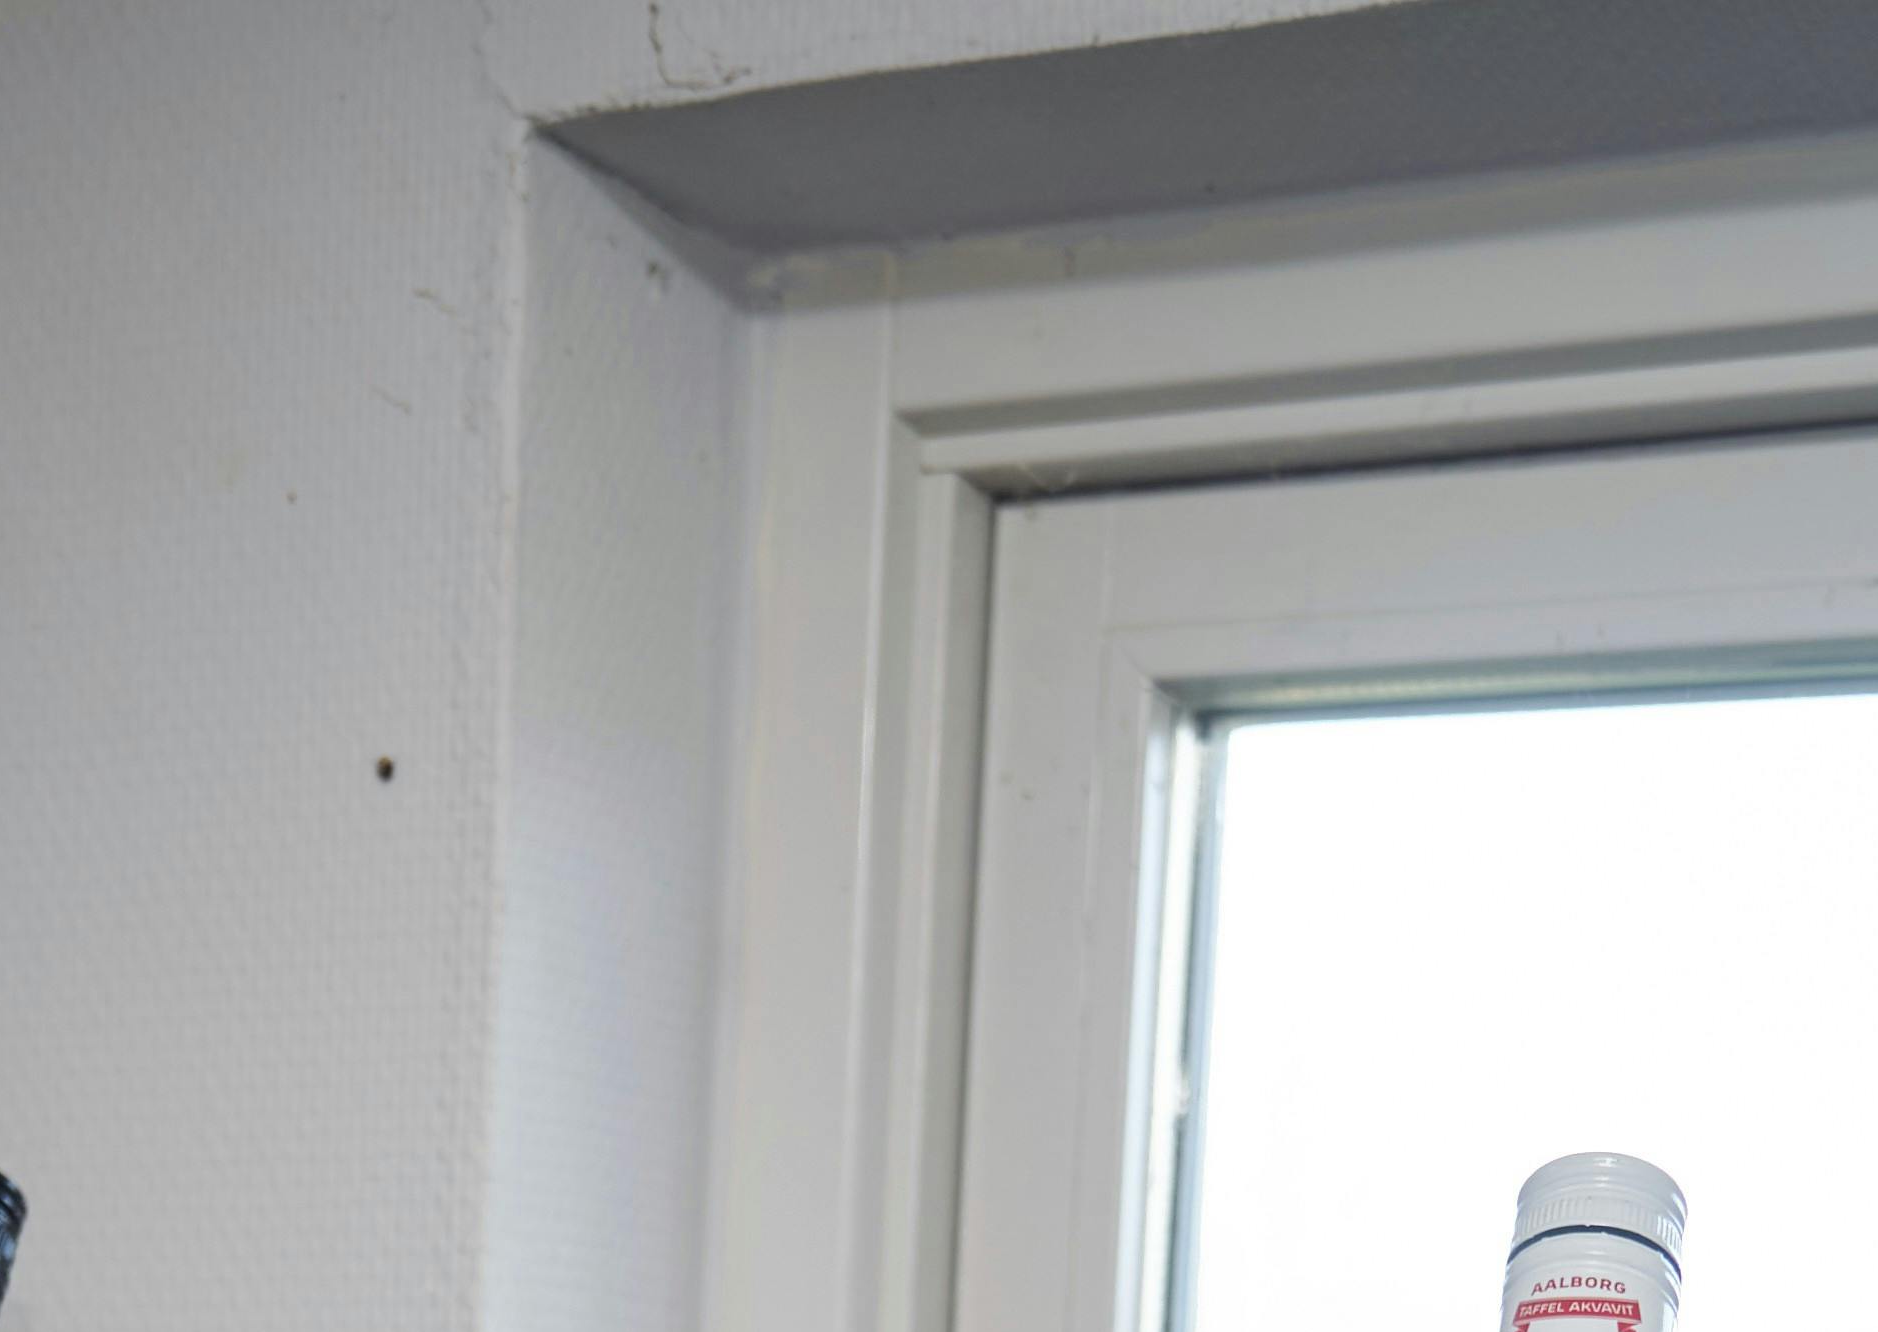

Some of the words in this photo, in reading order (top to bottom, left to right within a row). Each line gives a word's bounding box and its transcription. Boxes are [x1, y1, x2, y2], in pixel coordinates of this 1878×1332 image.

[1531, 1276, 1626, 1296] AALBORG
[1519, 1302, 1564, 1318] TAFFEL
[1568, 1301, 1634, 1316] AKVAVIT
